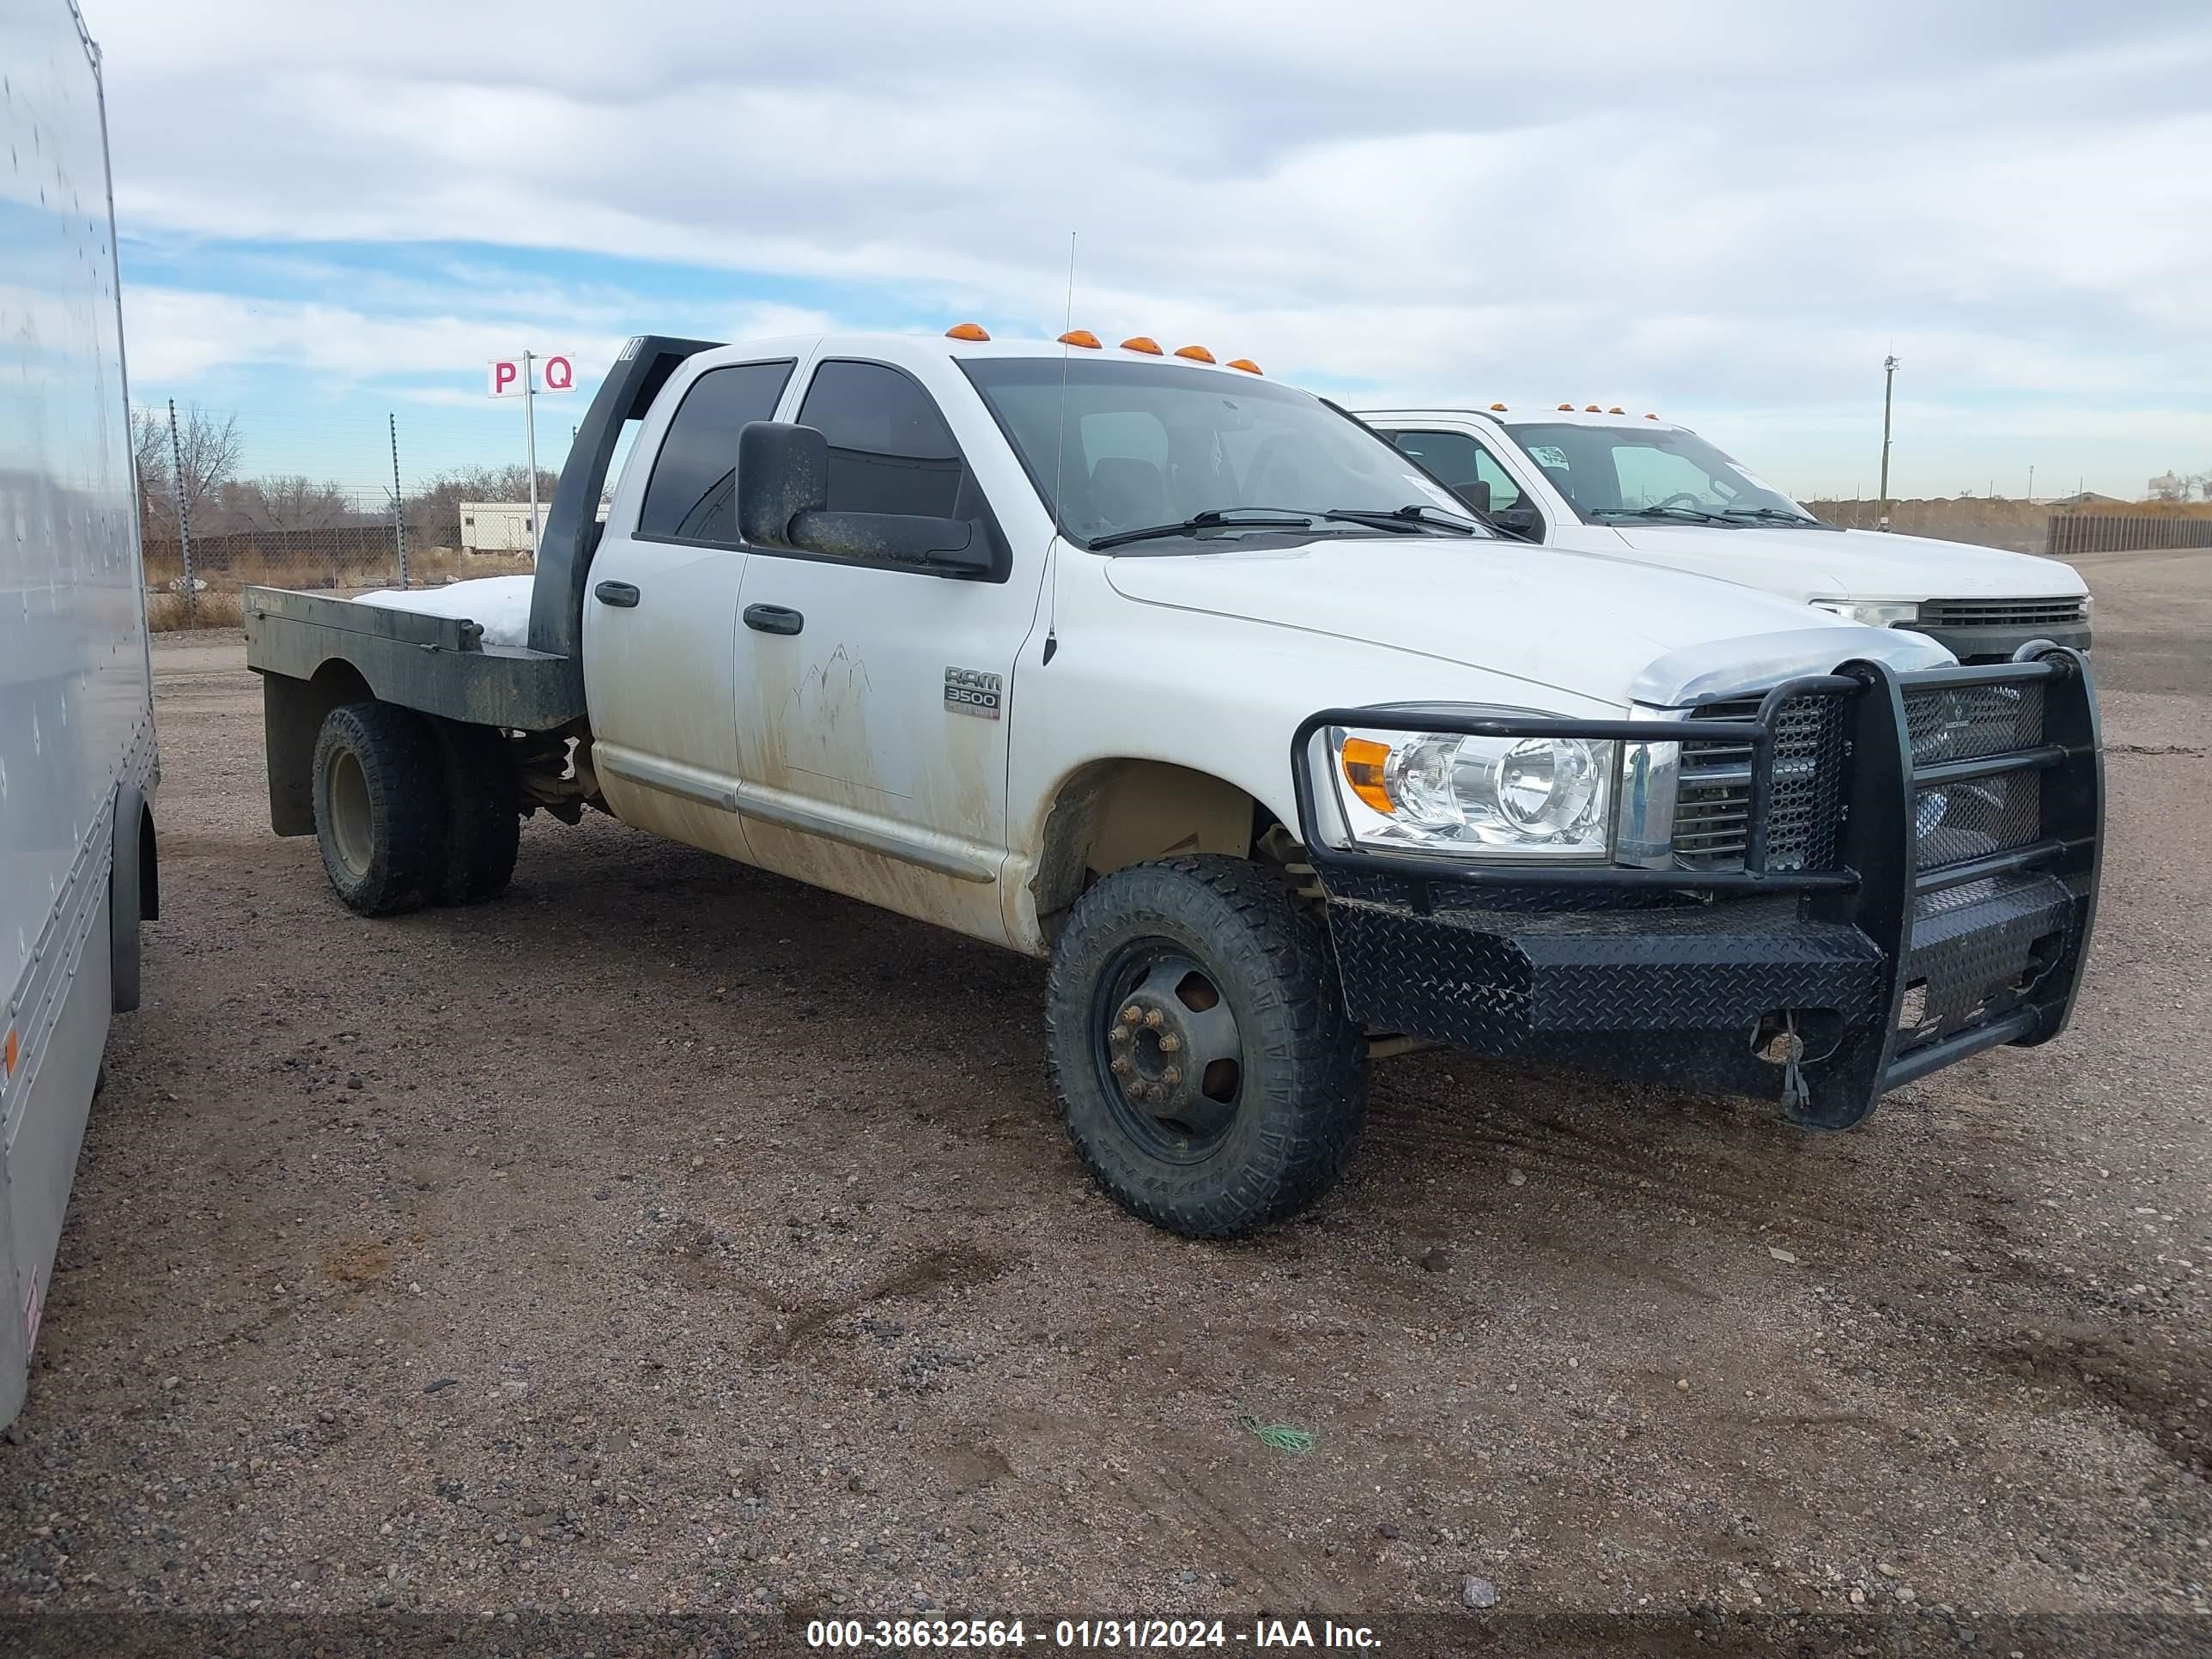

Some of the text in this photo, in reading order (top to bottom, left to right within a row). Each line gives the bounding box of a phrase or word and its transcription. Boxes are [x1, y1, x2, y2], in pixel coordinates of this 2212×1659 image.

[496, 362, 516, 393] P
[546, 356, 572, 389] Q
[945, 666, 1003, 690] RAM
[948, 688, 996, 707] 3500
